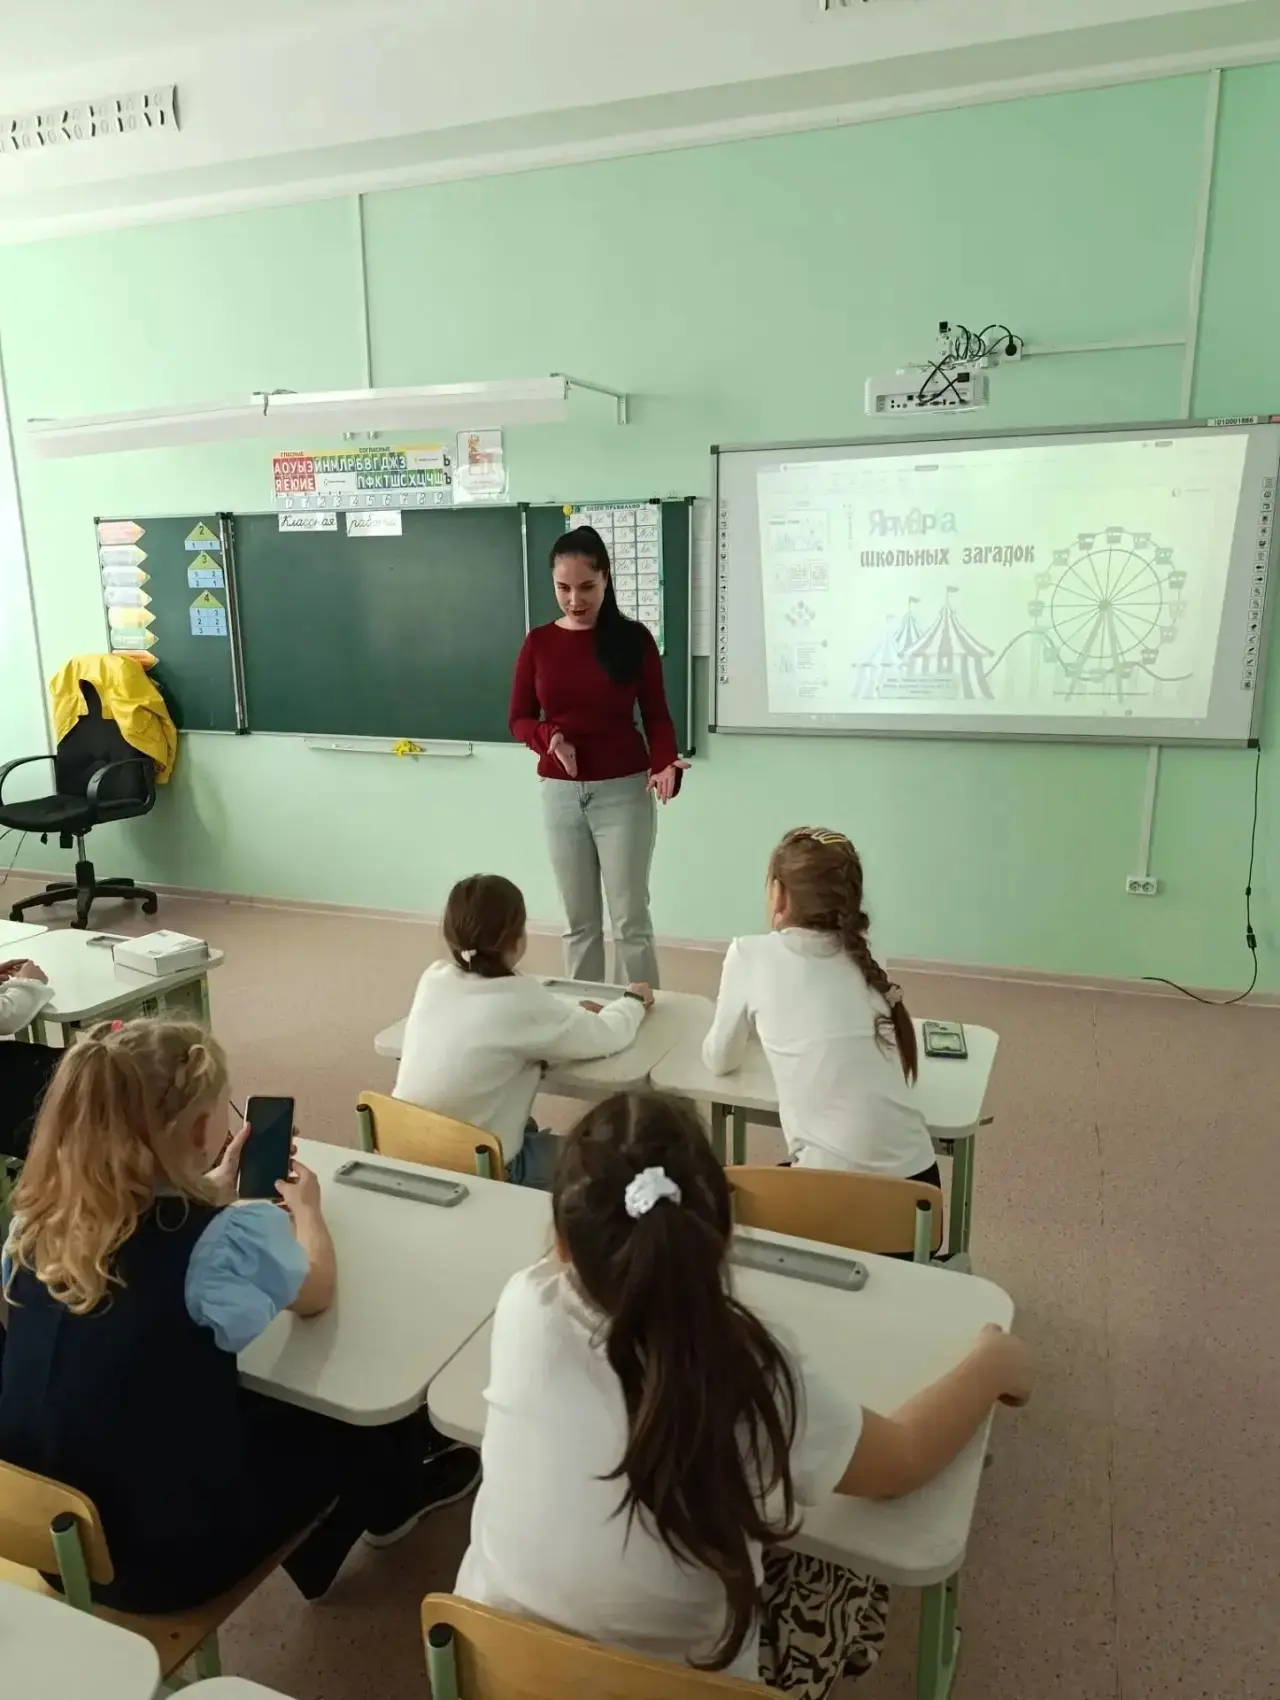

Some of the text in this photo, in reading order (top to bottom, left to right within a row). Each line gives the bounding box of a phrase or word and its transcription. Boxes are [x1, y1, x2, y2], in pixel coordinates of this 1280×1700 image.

[281, 514, 335, 527] Классая
[348, 513, 397, 534] раб
[868, 507, 959, 537] Ярмара
[860, 545, 1035, 568] школьных загадок
